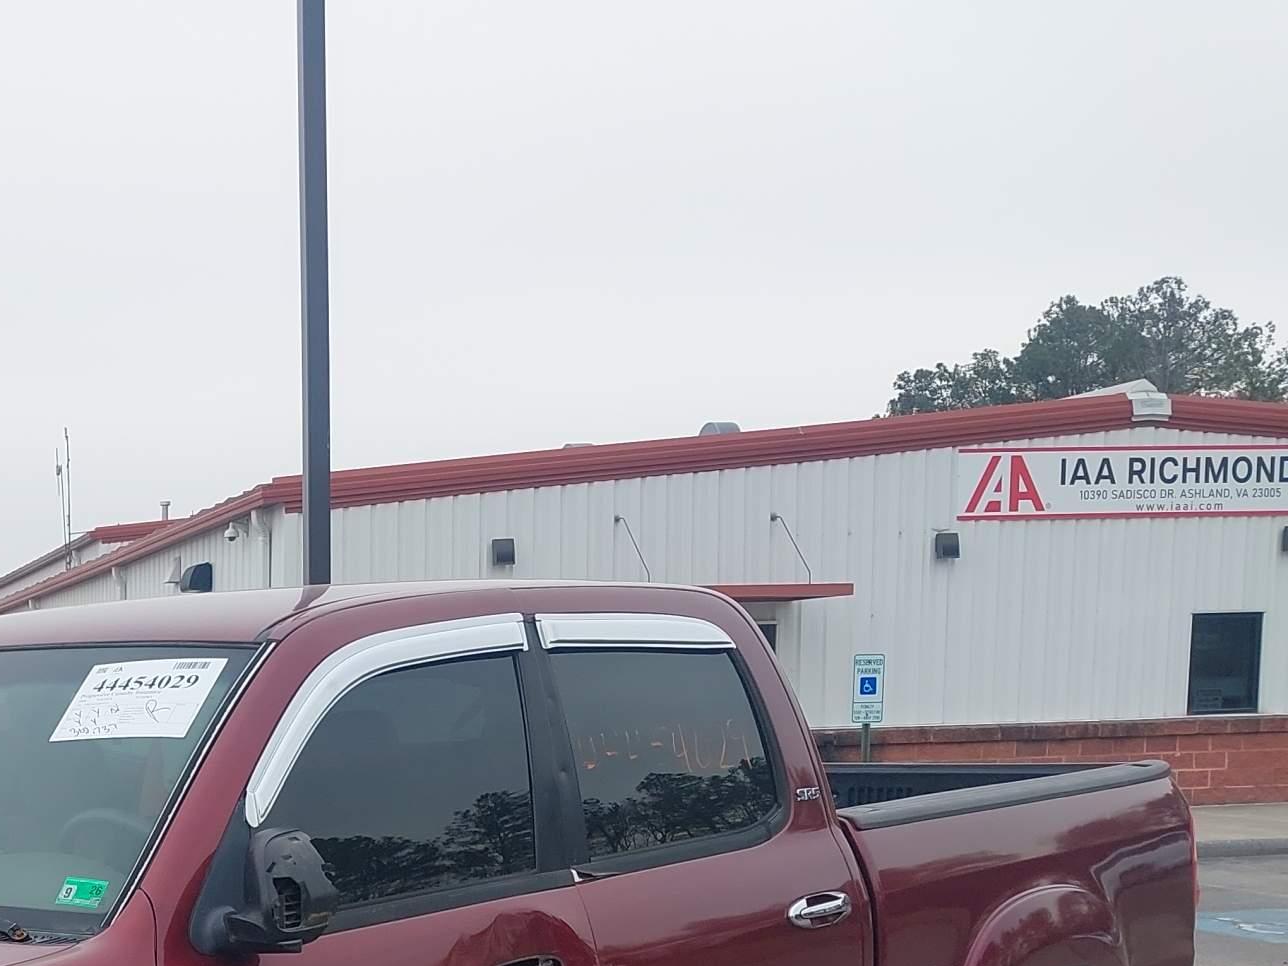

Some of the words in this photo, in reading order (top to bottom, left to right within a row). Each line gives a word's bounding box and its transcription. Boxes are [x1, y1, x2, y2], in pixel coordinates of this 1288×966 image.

[1059, 457, 1116, 486] IAA
[1079, 490, 1108, 500] 10390
[1111, 489, 1156, 500] SADISCO
[1160, 489, 1177, 499] DR.
[1180, 488, 1233, 500] ASHLAND,
[1235, 488, 1250, 498] VA
[1252, 487, 1282, 498] 23005
[1135, 502, 1224, 512] www.iaai.com
[93, 674, 200, 693] 44454029
[796, 787, 821, 801] SR5
[63, 887, 73, 898] 9
[89, 885, 103, 896] 26
